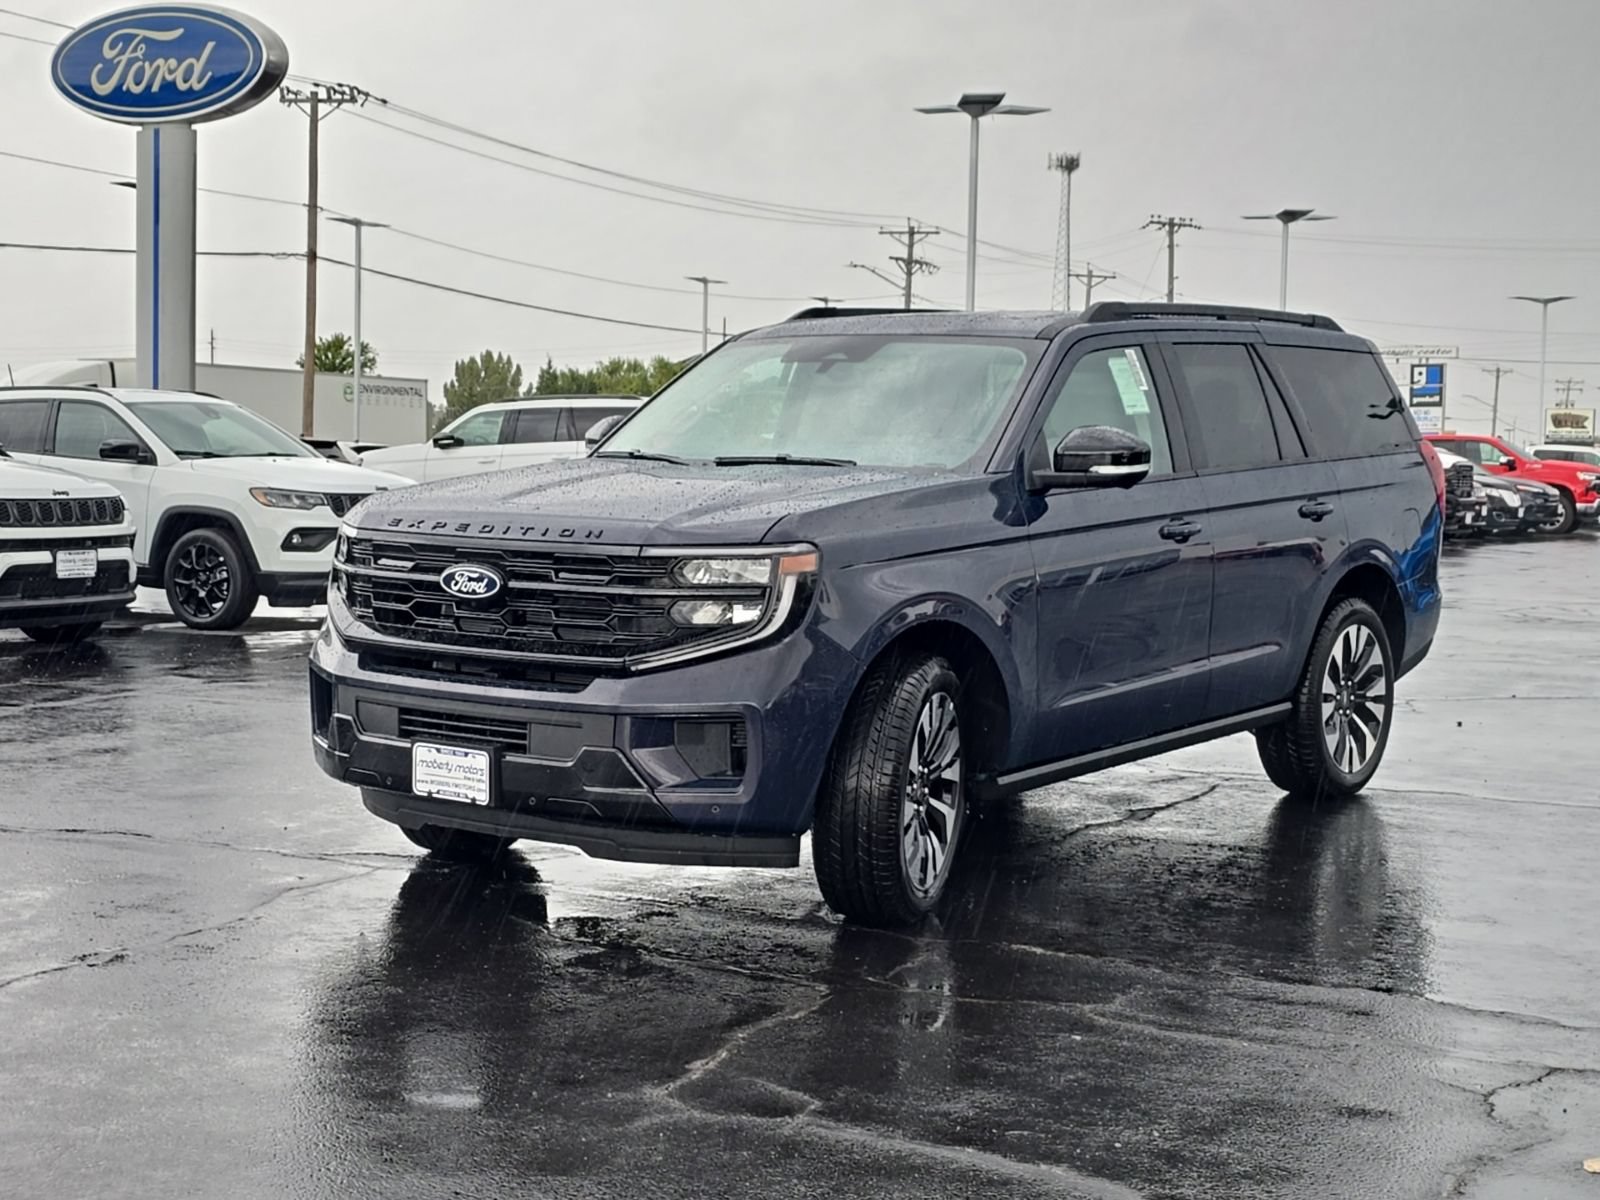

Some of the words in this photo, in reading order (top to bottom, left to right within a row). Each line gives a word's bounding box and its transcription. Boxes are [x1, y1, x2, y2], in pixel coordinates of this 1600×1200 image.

[91, 28, 216, 96] Ford
[359, 383, 423, 398] ENVIRONMENTAL
[388, 517, 604, 539] EXPEDITION
[451, 571, 488, 594] Ford
[454, 764, 485, 777] motors
